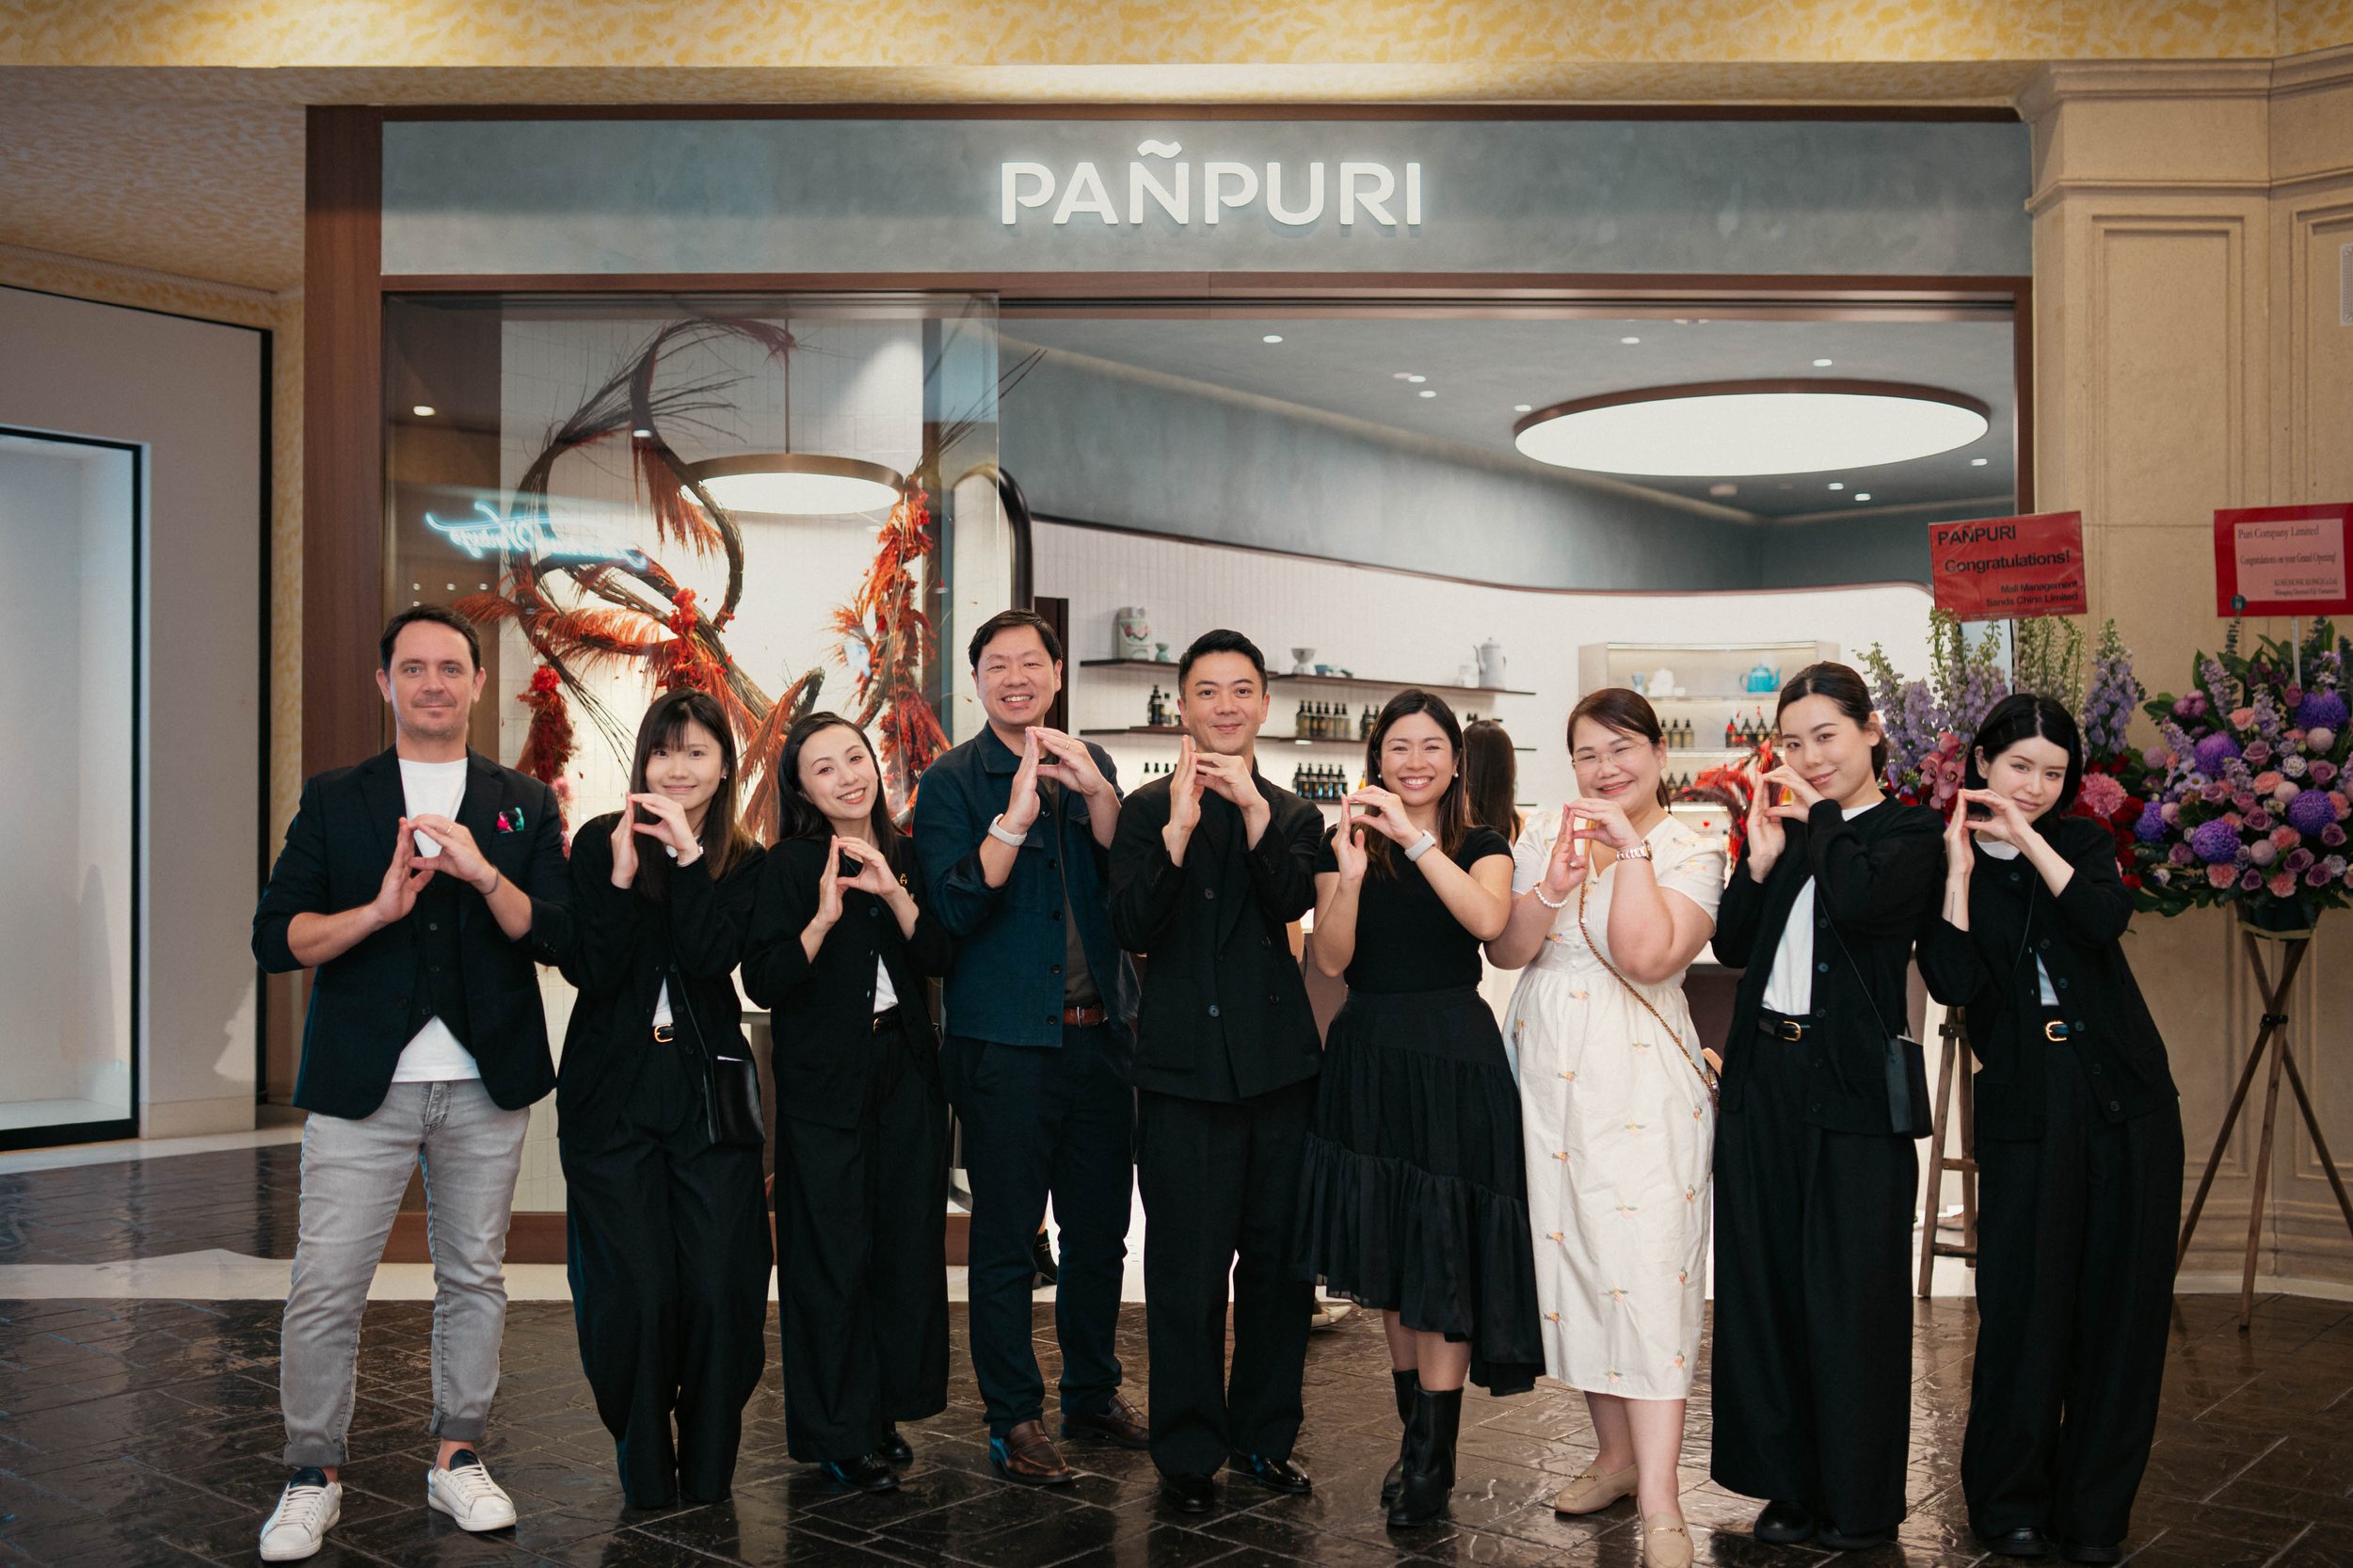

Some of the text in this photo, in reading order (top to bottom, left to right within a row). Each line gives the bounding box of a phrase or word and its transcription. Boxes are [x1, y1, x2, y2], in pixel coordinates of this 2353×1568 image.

[1001, 139, 1421, 225] PAÑPURI
[2254, 527, 2289, 541] Company
[2291, 525, 2320, 536] Limited
[1945, 550, 2070, 574] Congratulations!
[2001, 580, 2078, 594] Mall Management
[1986, 592, 2078, 607] Sands China Limited
